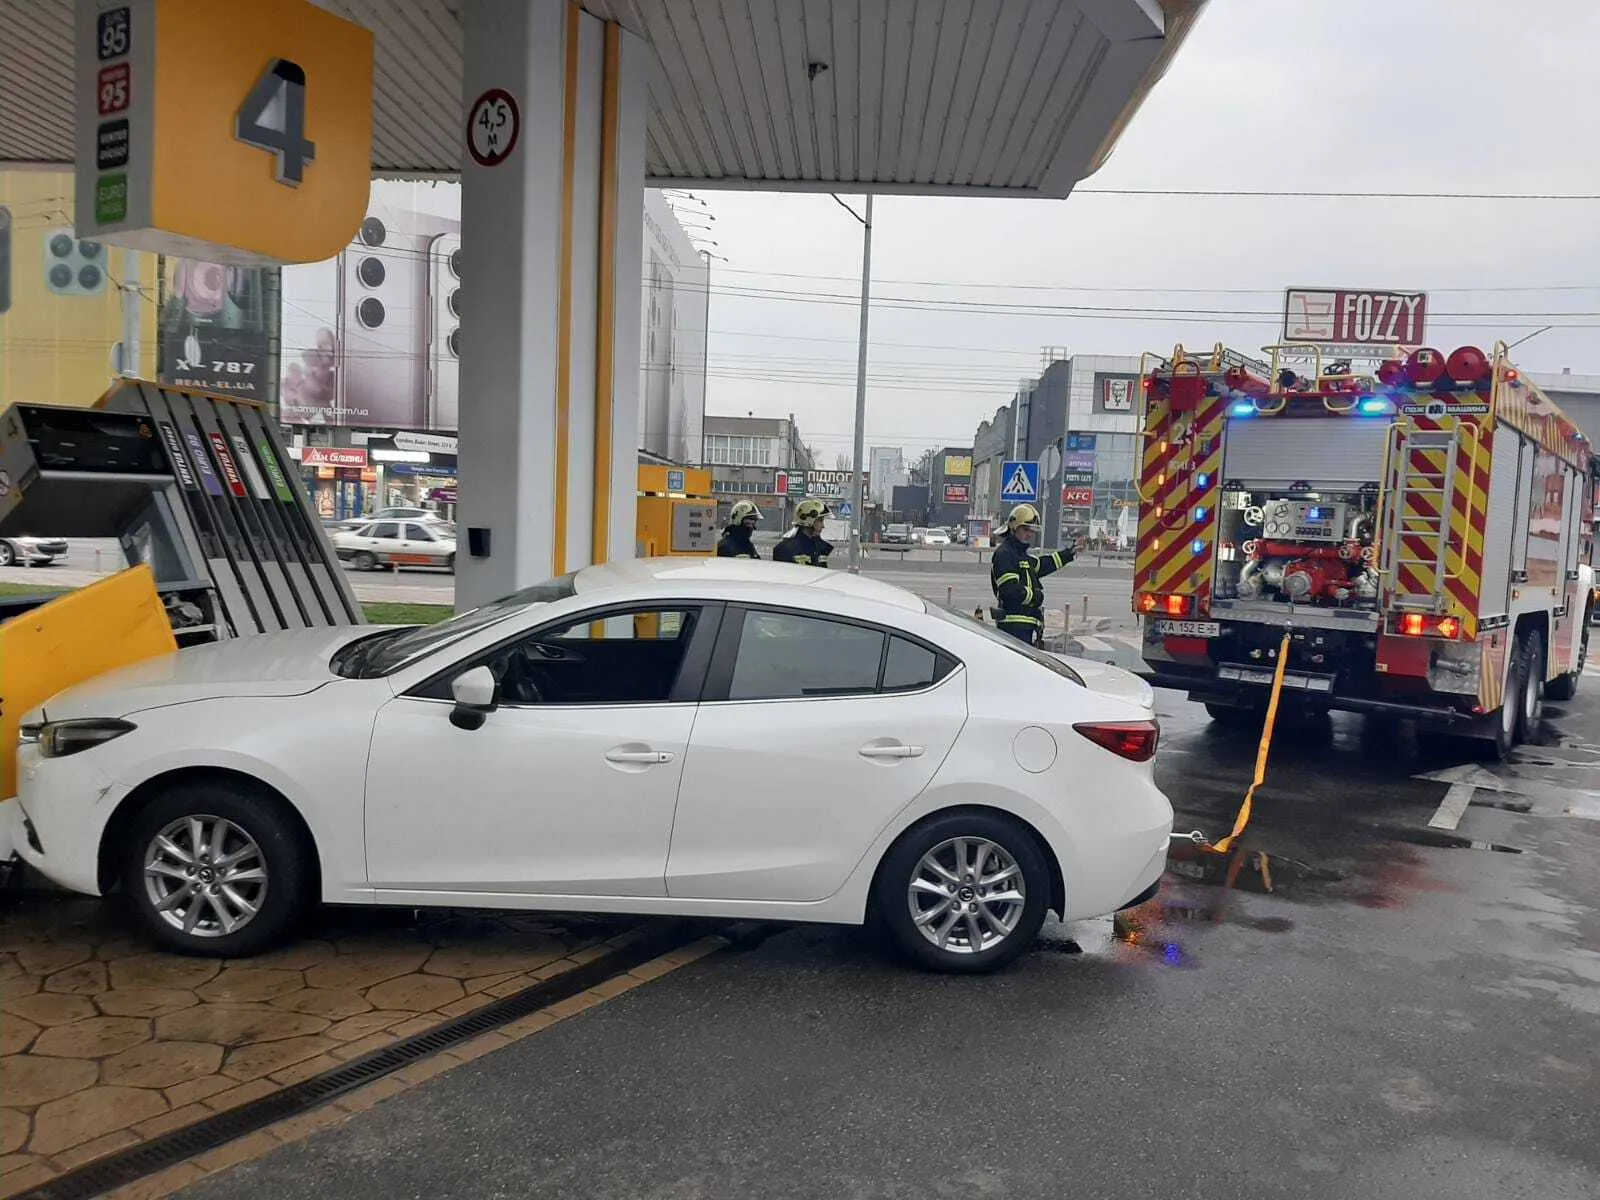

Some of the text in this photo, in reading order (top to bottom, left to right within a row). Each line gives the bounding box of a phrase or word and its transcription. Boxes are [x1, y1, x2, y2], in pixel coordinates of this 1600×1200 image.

[102, 24, 126, 57] 95
[101, 81, 127, 110] 95
[234, 57, 315, 189] 4
[479, 105, 506, 132] 4,5
[1342, 294, 1420, 342] FOZZY
[293, 405, 369, 416] samsung.com/ua
[807, 471, 854, 482] ПІДЛОГ
[1067, 492, 1090, 500] KFC
